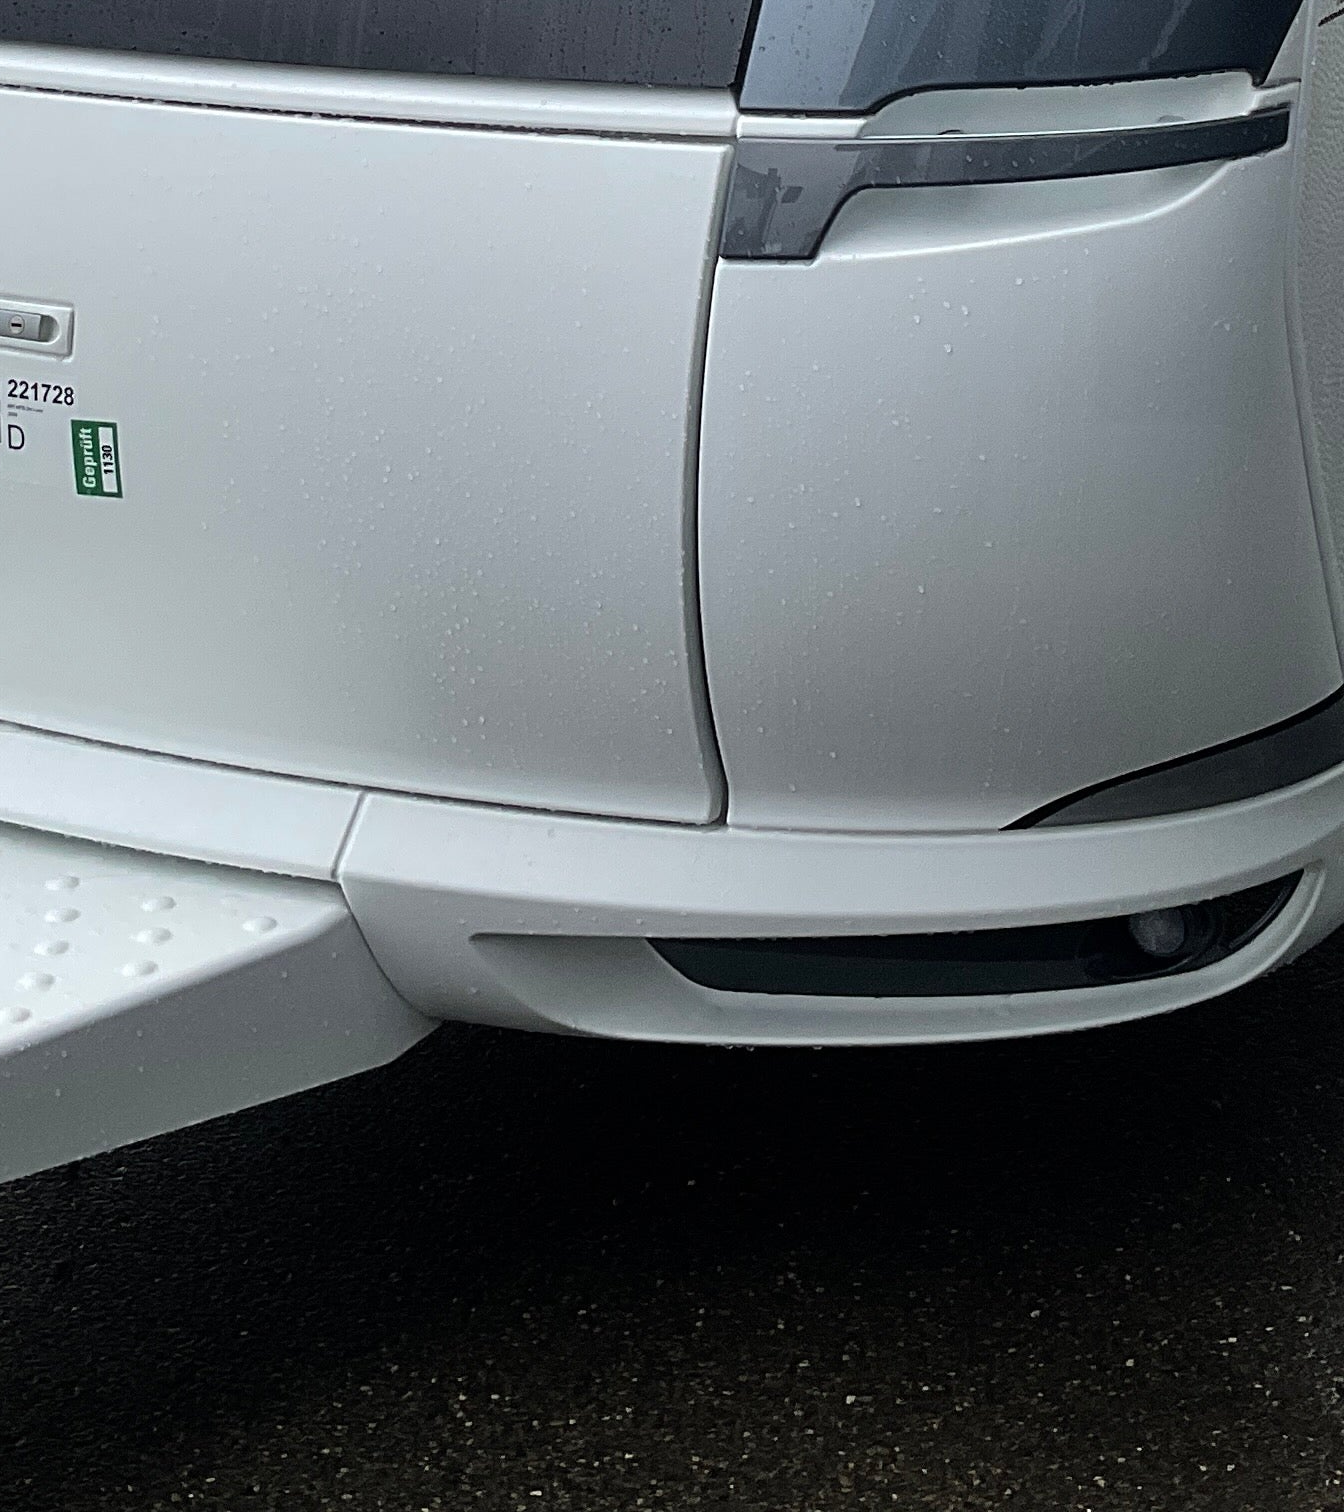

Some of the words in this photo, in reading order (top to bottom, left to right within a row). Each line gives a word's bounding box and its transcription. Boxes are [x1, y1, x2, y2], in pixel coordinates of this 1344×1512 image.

[7, 379, 75, 406] 221728
[7, 424, 25, 450] D
[79, 426, 97, 488] Geprüft
[102, 444, 114, 475] 1130
